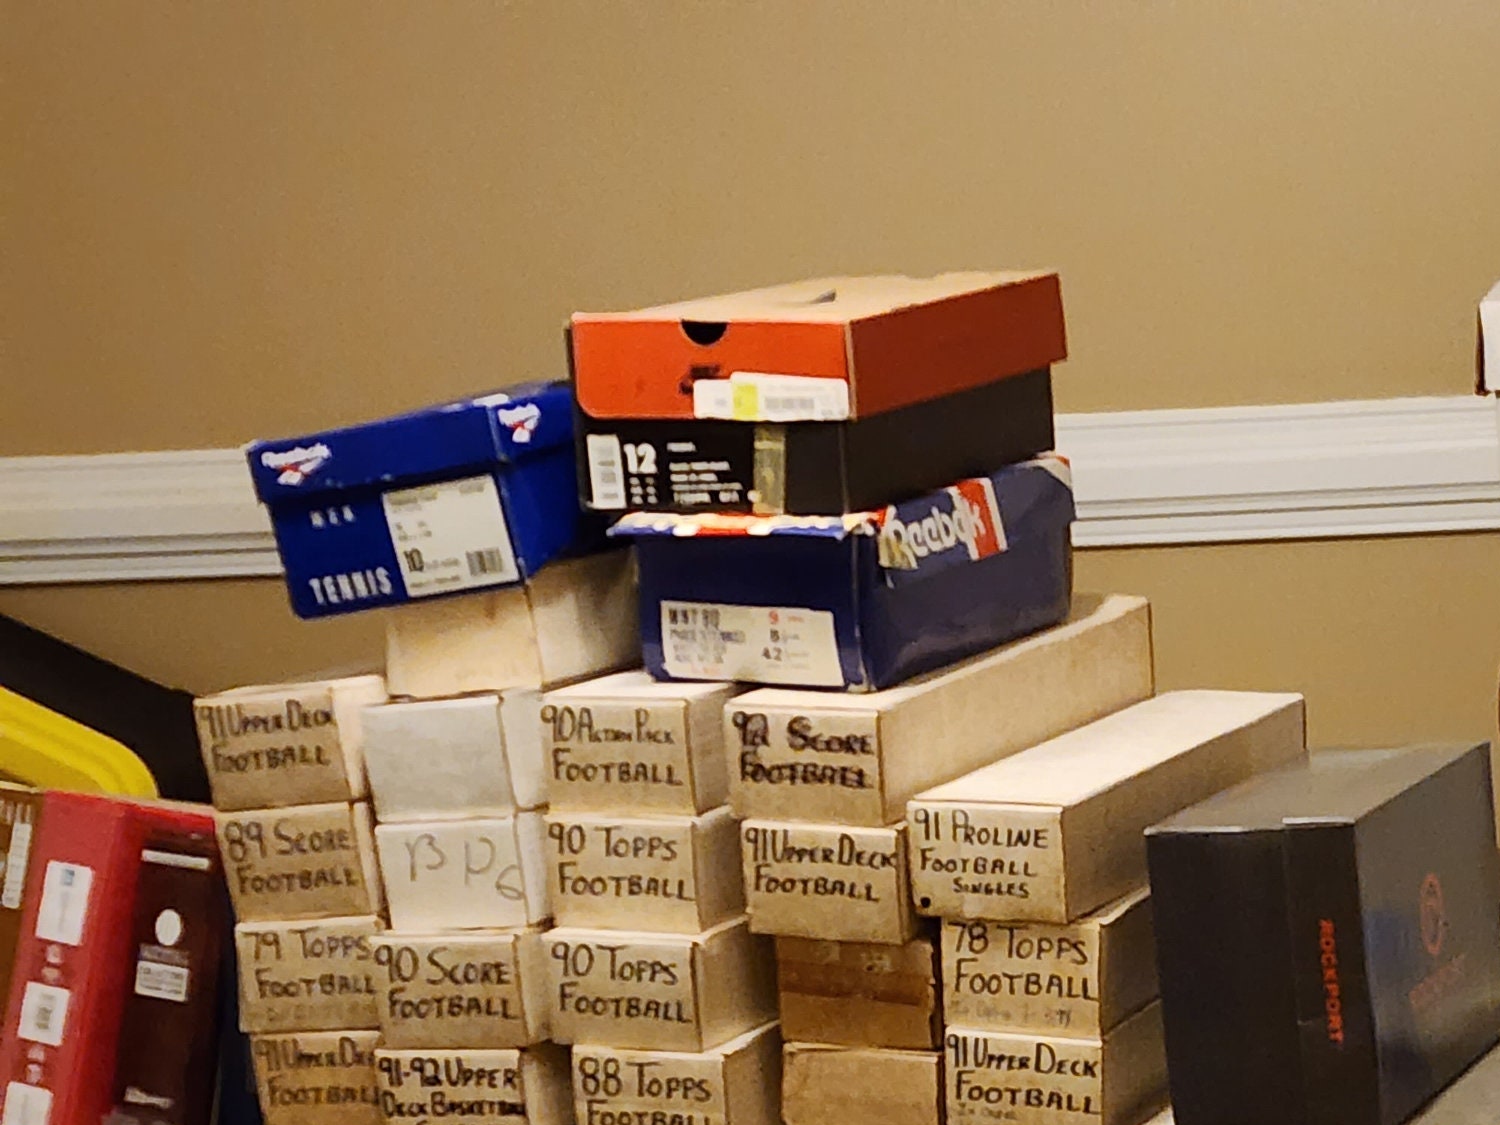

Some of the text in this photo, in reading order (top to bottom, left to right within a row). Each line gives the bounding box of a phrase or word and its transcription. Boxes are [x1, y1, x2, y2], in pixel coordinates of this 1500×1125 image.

[624, 443, 657, 474] 12
[309, 566, 393, 605] TENNIS
[540, 705, 577, 743] 90
[786, 715, 876, 755] SCORE
[211, 741, 332, 773] FOOTBALL
[551, 747, 684, 787] FOOTBALL
[739, 750, 875, 790] FOOTBALL
[223, 817, 352, 863] 89 SCORE
[547, 822, 678, 862] 90 TOPPS
[914, 807, 941, 843] 91
[745, 827, 770, 862] 91
[837, 832, 899, 870] DECK
[919, 848, 1039, 878] FOOTBALL
[237, 859, 362, 897] FOOTBALL
[557, 862, 698, 902] FOOTBALL
[754, 864, 881, 903] FOOTBALL
[953, 877, 1031, 900] SINGLES
[242, 928, 370, 963] 79 TOPPS
[549, 942, 678, 985] 90 TOPPS
[947, 922, 1089, 966] 78 TOPPS
[255, 967, 376, 999] FOOTBALL
[373, 943, 513, 987] 90 SCORE
[954, 957, 1100, 1002] FOOTBALL
[388, 990, 521, 1022] FOOTBALL
[557, 981, 694, 1025] FOOTBALL
[443, 1056, 521, 1090] UPPER
[946, 1034, 1099, 1079] 91 UPPER DECK
[578, 1056, 713, 1102] 88 TOPPS
[955, 1069, 1101, 1116] FOOTBALL
